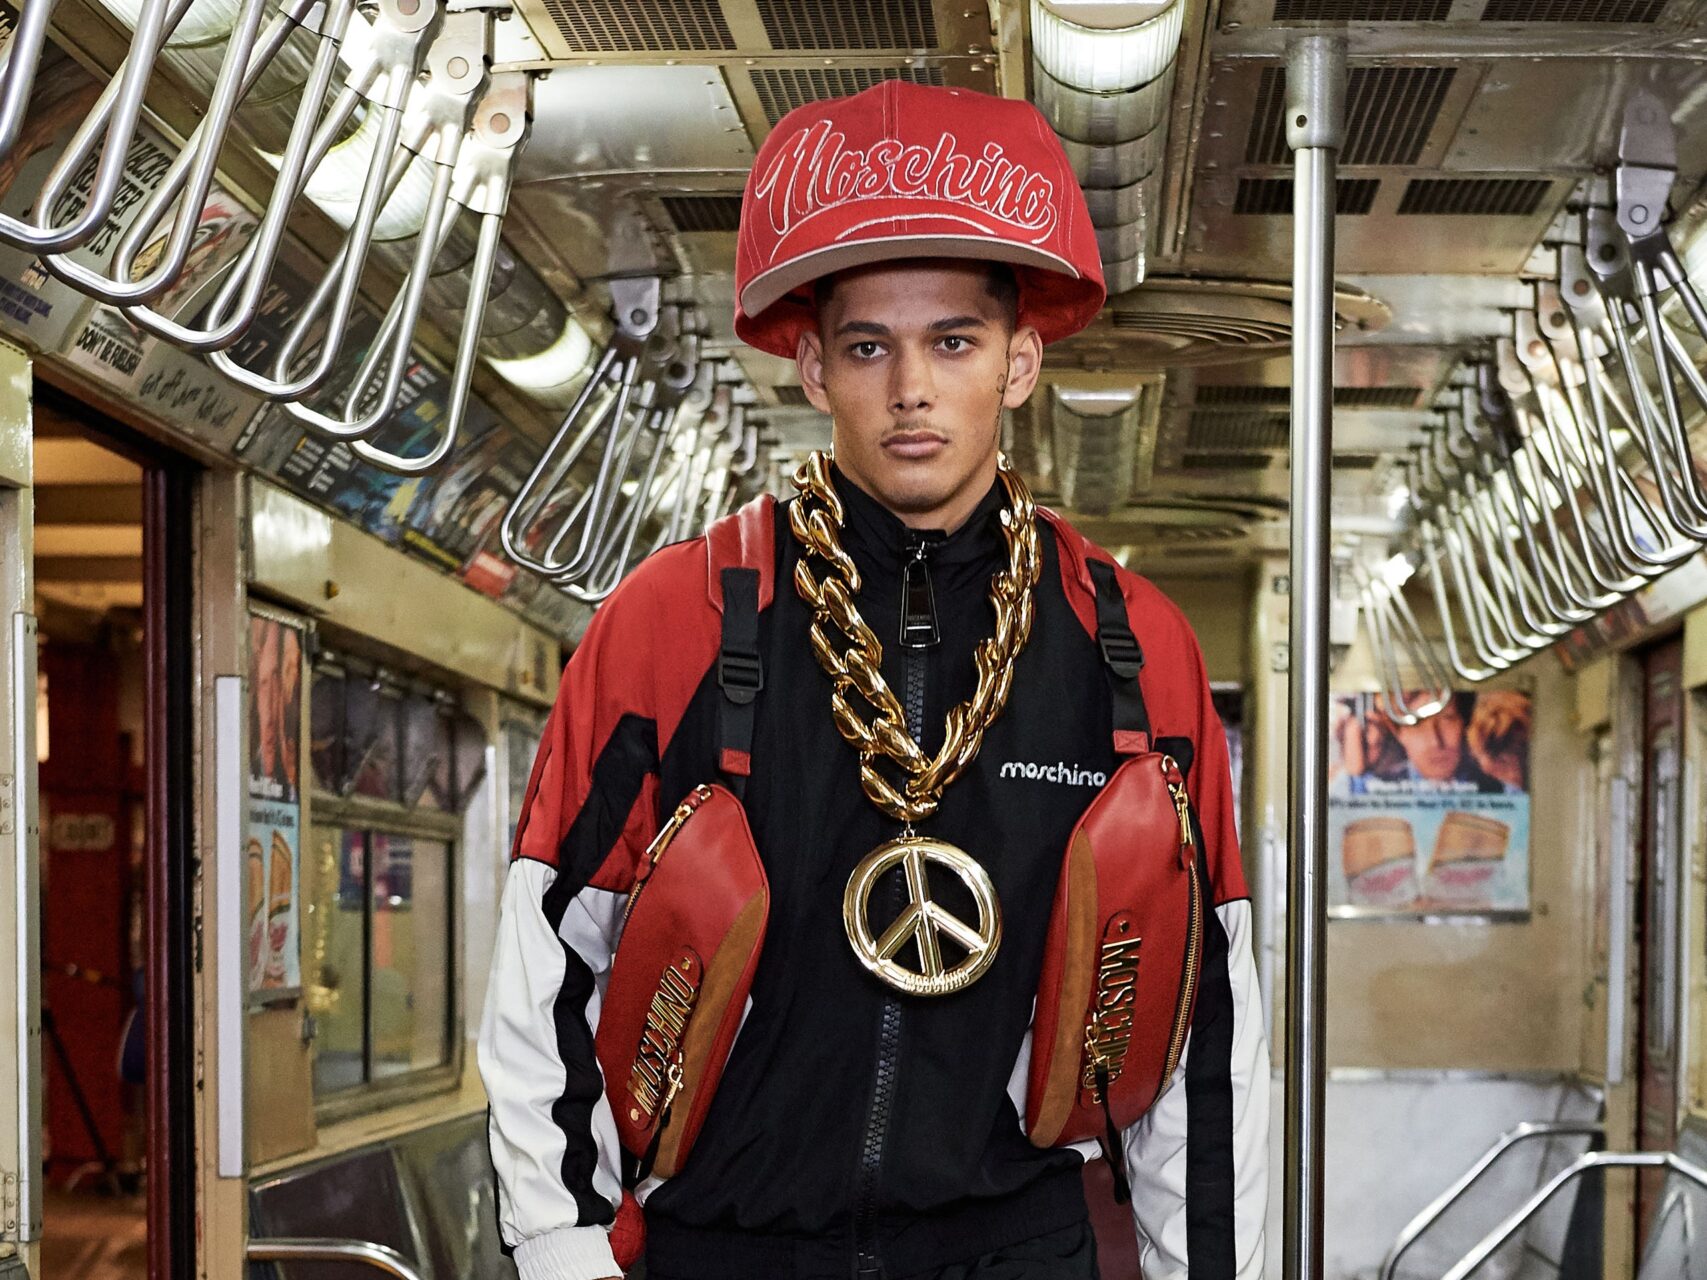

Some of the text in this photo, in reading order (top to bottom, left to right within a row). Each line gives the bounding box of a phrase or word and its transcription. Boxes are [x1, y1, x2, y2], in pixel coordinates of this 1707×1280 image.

[755, 120, 1056, 235] Moschino
[76, 326, 107, 357] DON'T
[1000, 762, 1106, 786] moschino
[626, 965, 694, 1116] MOSCHINO
[1083, 938, 1141, 1088] MOSCHINO
